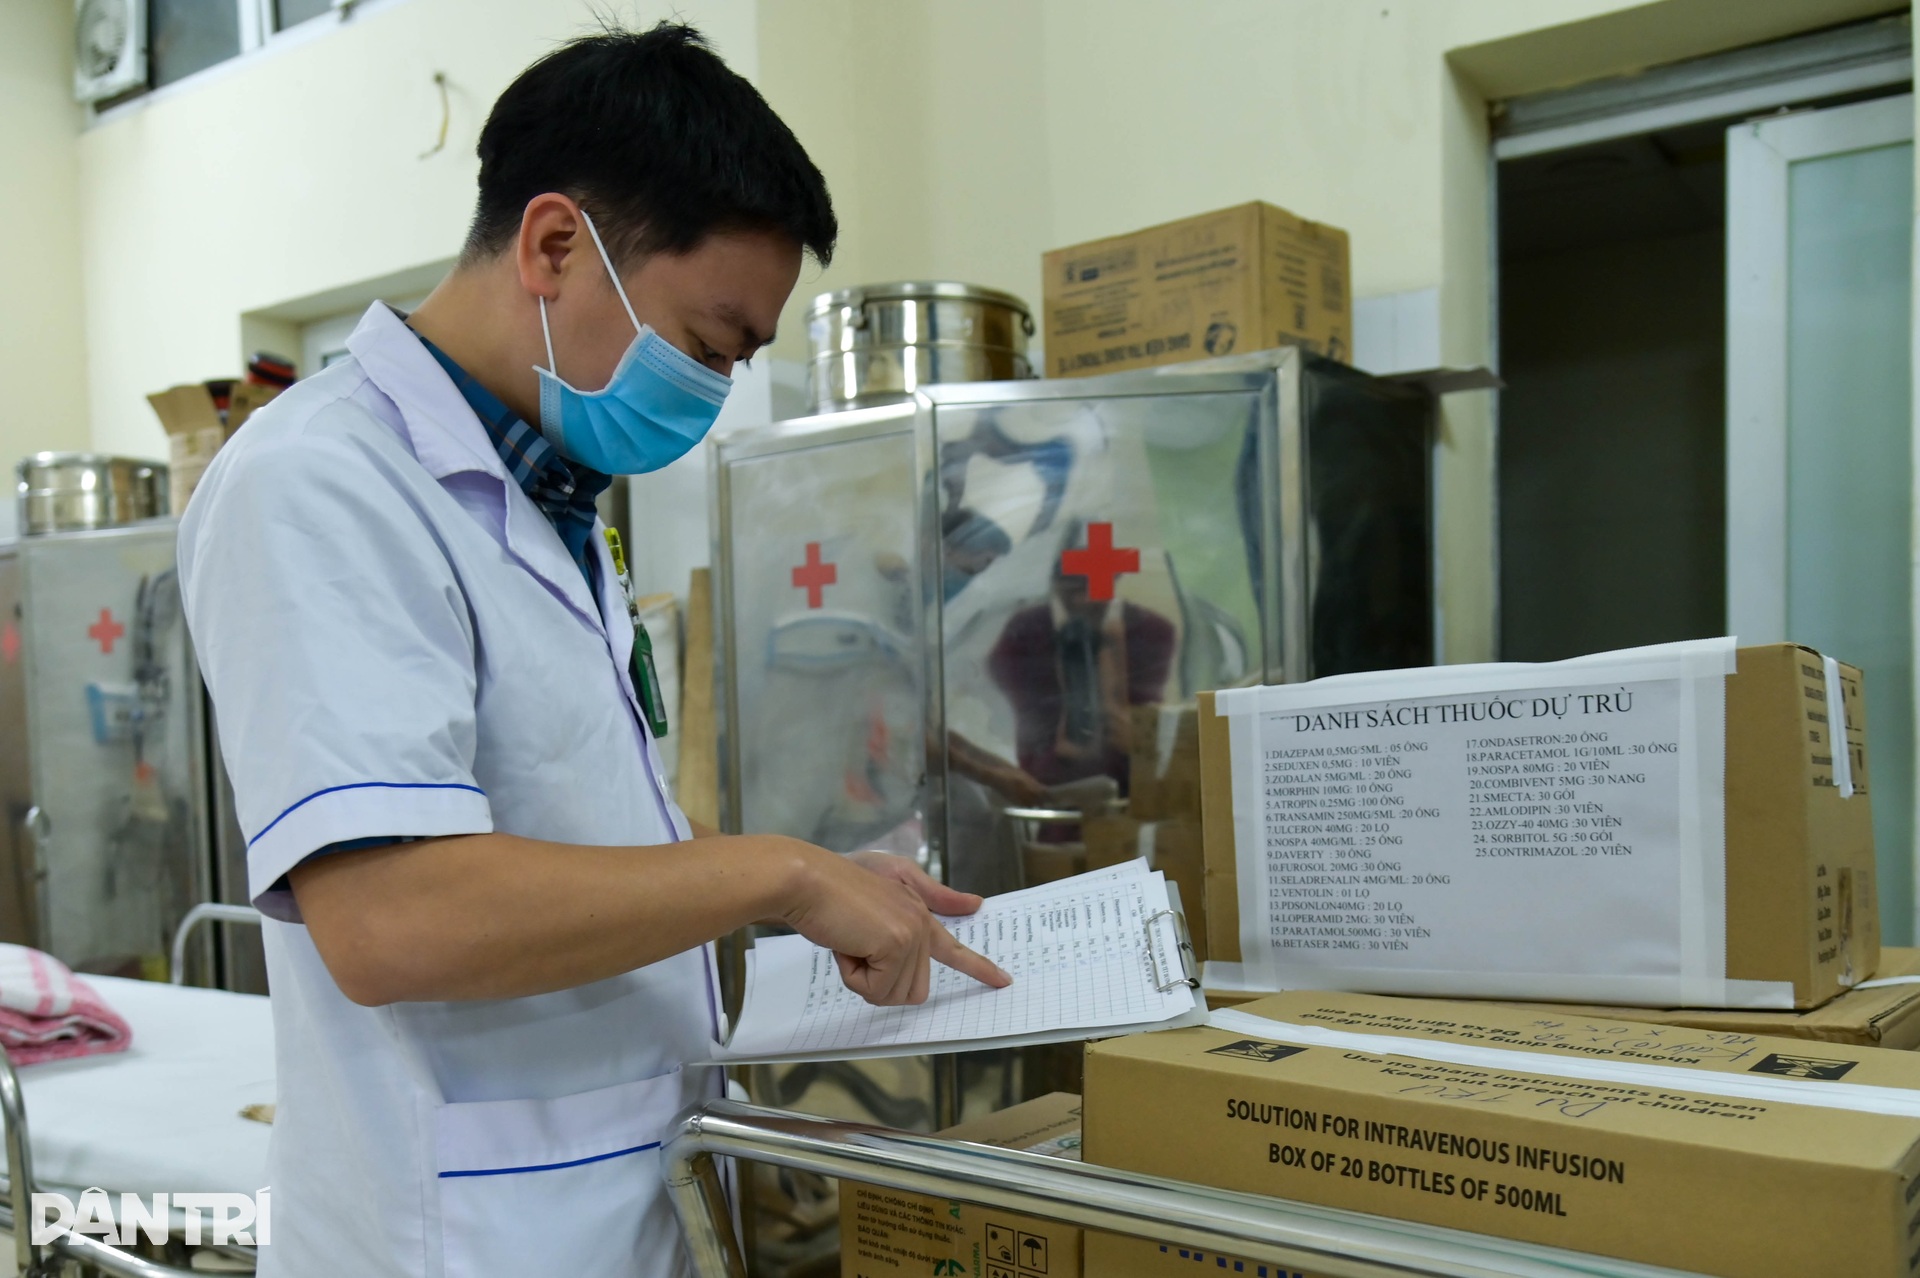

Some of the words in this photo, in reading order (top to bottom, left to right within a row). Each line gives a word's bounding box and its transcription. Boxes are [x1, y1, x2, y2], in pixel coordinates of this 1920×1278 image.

[1295, 712, 1359, 732] DANH
[1366, 703, 1429, 728] SÁCH
[1437, 695, 1525, 724] THUỐC
[1531, 693, 1572, 720] DỰ
[1578, 687, 1634, 714] TRÙ
[1466, 734, 1577, 748] 17.ONDASETRON:20
[1580, 731, 1608, 743] ỐNG
[1265, 748, 1324, 759] 1.DIAZEPAM
[1327, 744, 1382, 756] 0,5MG/5ML
[1390, 744, 1401, 752] 05
[1404, 741, 1428, 751] ỐNG
[1466, 749, 1570, 762] 18.PARACETAMOL
[1574, 746, 1625, 757] 1G/10ML
[1628, 744, 1645, 755] :30
[1648, 742, 1678, 754] ỐNG
[1265, 761, 1319, 771] 2.SEDUXEN
[1322, 759, 1352, 769] 0,5MG
[1362, 759, 1371, 767] 10
[1374, 755, 1400, 766] VIÊN
[1467, 766, 1519, 776] 19.NOSPA
[1523, 764, 1554, 774] 80MG
[1564, 762, 1576, 771] 20
[1580, 758, 1610, 771] VIÊN
[1265, 774, 1321, 784] 3.ZODALAN
[1325, 772, 1365, 781] 5MG/ML
[1374, 771, 1385, 780] 20
[1388, 769, 1412, 779] ỐNG
[1470, 777, 1555, 789] 20.COMBIVENT
[1559, 776, 1585, 786] 5MG
[1588, 775, 1605, 785] :30
[1608, 773, 1645, 784] NANG
[1265, 786, 1319, 796] 4.MORPHIN
[1323, 785, 1353, 794] 10MG:
[1356, 785, 1366, 793] 10
[1369, 783, 1392, 792] ỐNG
[1469, 792, 1535, 803] 21.SMECTA:
[1539, 791, 1550, 801] 30
[1553, 789, 1575, 801] GÓI
[1266, 800, 1318, 809] 5.ATROPIN
[1320, 798, 1355, 807] 0.25MG
[1358, 798, 1378, 806] :100
[1380, 796, 1404, 806] ỐNG
[1469, 805, 1551, 817] 22.AMLODIPIN
[1555, 804, 1570, 814] :30
[1573, 801, 1603, 813] VIÊN
[1266, 811, 1335, 822] 6.TRANSAMIN
[1338, 810, 1396, 821] 250MG/5ML
[1399, 809, 1413, 818] :20
[1415, 807, 1440, 817] ỐNG
[1267, 825, 1323, 834] 7.ULCERON
[1325, 824, 1352, 833] 40MG
[1361, 824, 1372, 832] 20
[1375, 823, 1389, 834] LỌ
[1472, 819, 1534, 830] 23.OZZY-40
[1537, 818, 1569, 828] 40MG
[1572, 818, 1588, 828] :30
[1591, 815, 1622, 827] VIÊN
[1267, 838, 1308, 847] 8.NOSPA
[1310, 837, 1356, 846] 40MG/ML
[1365, 837, 1376, 845] 25
[1379, 836, 1403, 845] ỐNG
[1474, 834, 1488, 844] 24.
[1491, 833, 1549, 843] SORBITOL
[1553, 832, 1567, 842] 5G
[1571, 832, 1587, 842] :50
[1590, 831, 1613, 841] GÓI
[1267, 851, 1323, 859] 9.DAVERTY
[1335, 850, 1346, 858] 30
[1348, 849, 1371, 858] ỐNG
[1475, 846, 1578, 857] 25.CONTRIMAZOL
[1581, 846, 1597, 856] :20
[1600, 843, 1633, 855] VIÊN
[1268, 863, 1327, 872] 10.FUROSOL
[1330, 863, 1358, 872] 20MG
[1361, 862, 1375, 871] :30
[1377, 861, 1401, 871] ỐNG
[1269, 875, 1360, 885] 11.SELADRENALIN
[1363, 875, 1409, 884] 4MG/ML:
[1412, 875, 1423, 884] 20
[1426, 874, 1450, 884] ỐNG
[1269, 889, 1333, 897] 12.VENTOLIN
[1341, 889, 1351, 897] 01
[1355, 889, 1370, 899] LỌ
[1269, 901, 1365, 911] 13.PDSONLON40MG
[1373, 902, 1384, 911] 20
[1387, 902, 1402, 912] LỌ
[1270, 914, 1342, 923] 14.LOPERAMID
[1346, 914, 1371, 923] 2MG:
[1374, 914, 1385, 923] 30
[1388, 913, 1414, 924] VIÊN
[1270, 927, 1381, 937] 15.PARATAMOL500MG
[1390, 928, 1401, 937] 30
[1404, 927, 1431, 937] VIÊN
[1271, 939, 1329, 948] 16.BETASER
[1332, 940, 1360, 949] 24MG
[1369, 941, 1379, 950] 30
[1382, 939, 1409, 950] VIÊN
[1343, 1054, 1382, 1064] Use
[1421, 1066, 1488, 1077] sharp
[1494, 1074, 1651, 1097] instruments
[1658, 1093, 1686, 1102] to
[1693, 1099, 1767, 1112] open
[1380, 1068, 1439, 1079] Keep
[1523, 1086, 1595, 1099] reach
[1603, 1095, 1636, 1103] of
[1638, 1100, 1757, 1120] children
[1226, 1098, 1317, 1132] SOLUTION
[1322, 1114, 1360, 1140] FOR
[1364, 1120, 1510, 1165] INTRAVENOUS
[1516, 1145, 1625, 1184] INFUSION
[1268, 1143, 1307, 1168] BOX
[1311, 1150, 1336, 1173] OF
[1340, 1156, 1364, 1178] 20
[1368, 1159, 1455, 1195] BOTTLES
[1460, 1177, 1489, 1200] OF
[1495, 1183, 1567, 1217] 500ML
